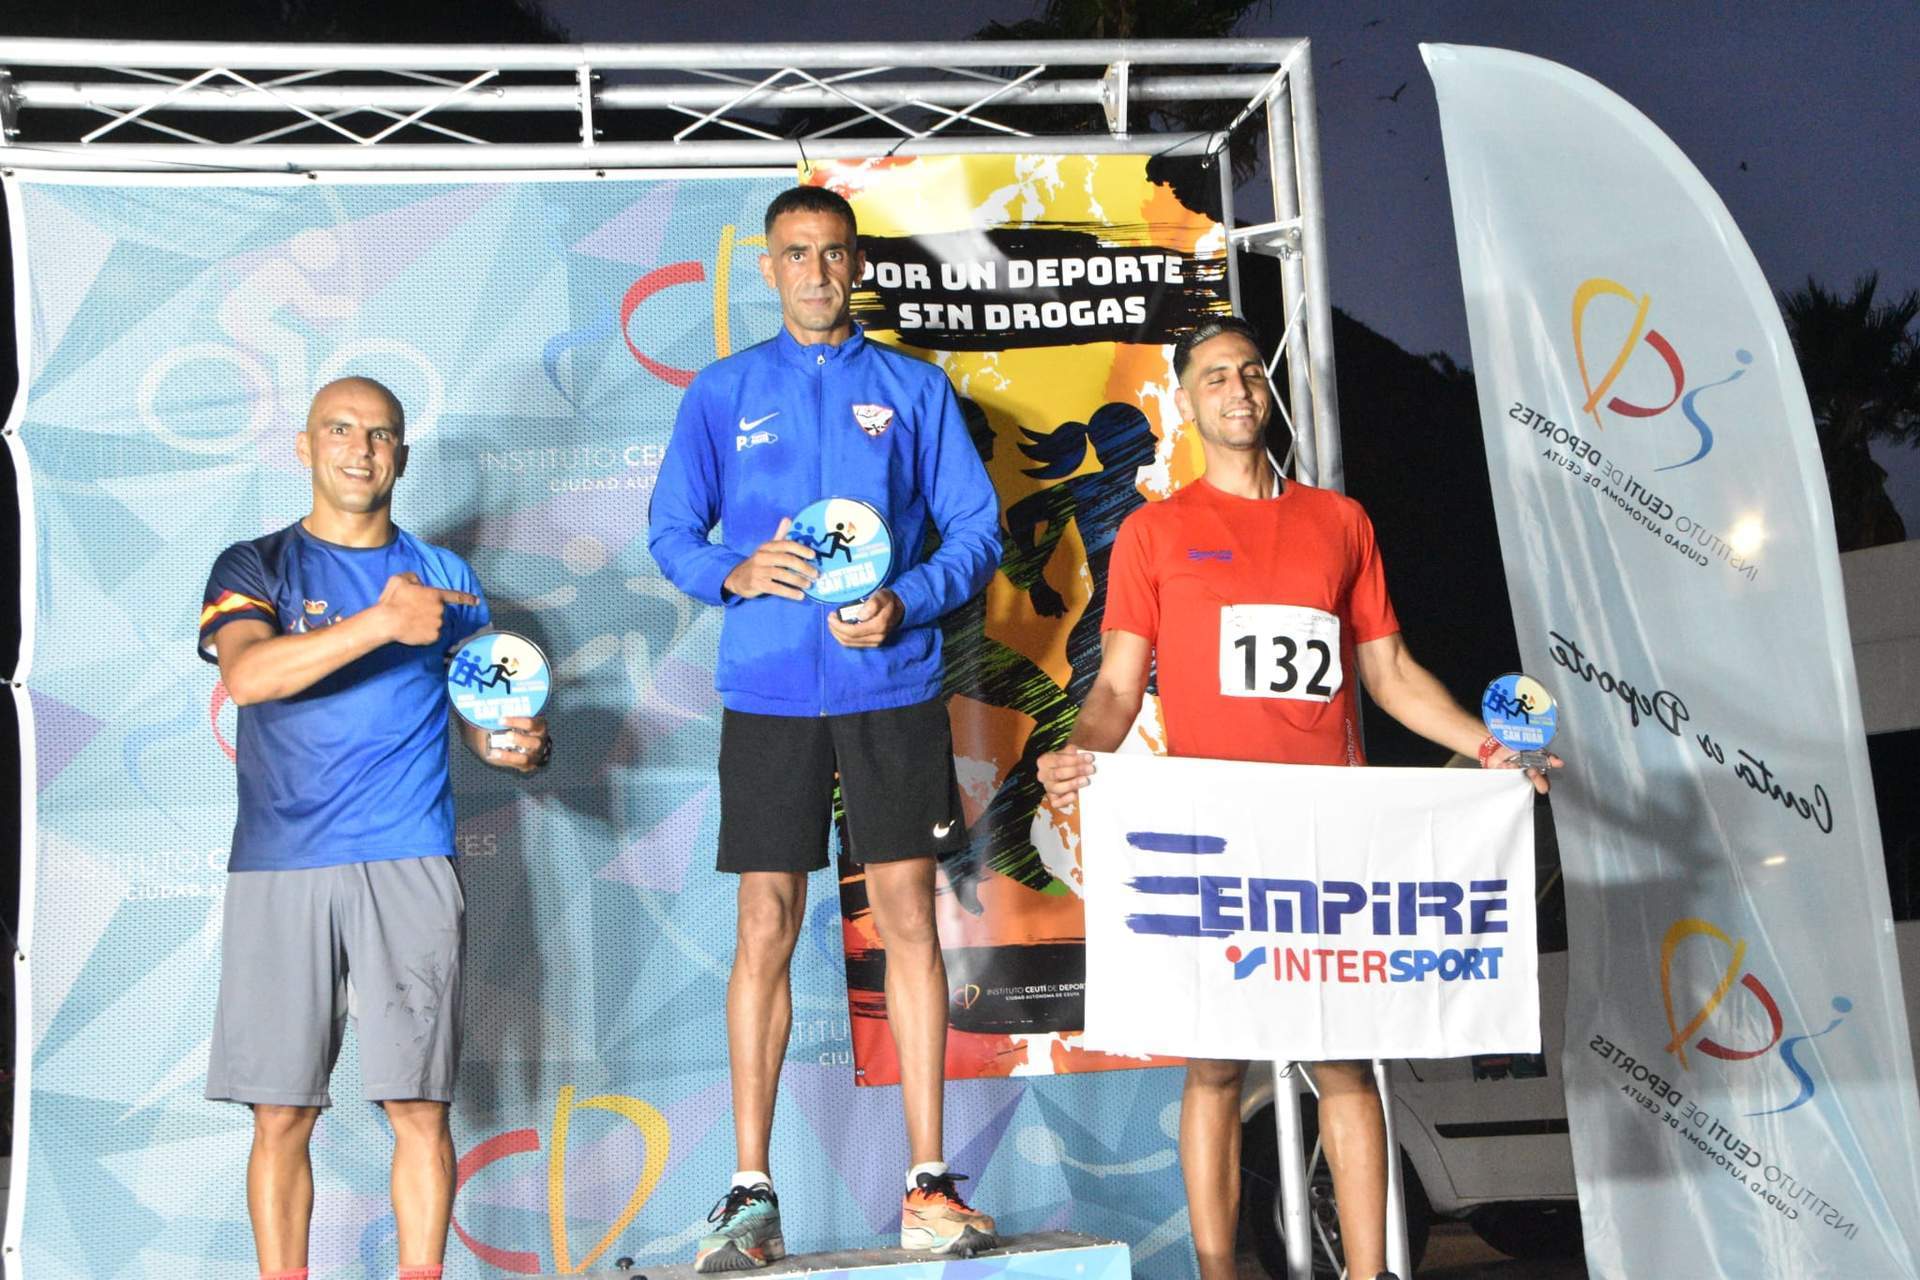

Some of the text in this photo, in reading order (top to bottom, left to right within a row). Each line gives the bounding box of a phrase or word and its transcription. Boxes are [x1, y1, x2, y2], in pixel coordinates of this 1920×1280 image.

[852, 255, 1185, 291] POR UN DEPORTE
[899, 296, 1146, 331] SIN DROGAS
[1234, 634, 1331, 697] 132
[1273, 946, 1504, 983] INTERSPORT
